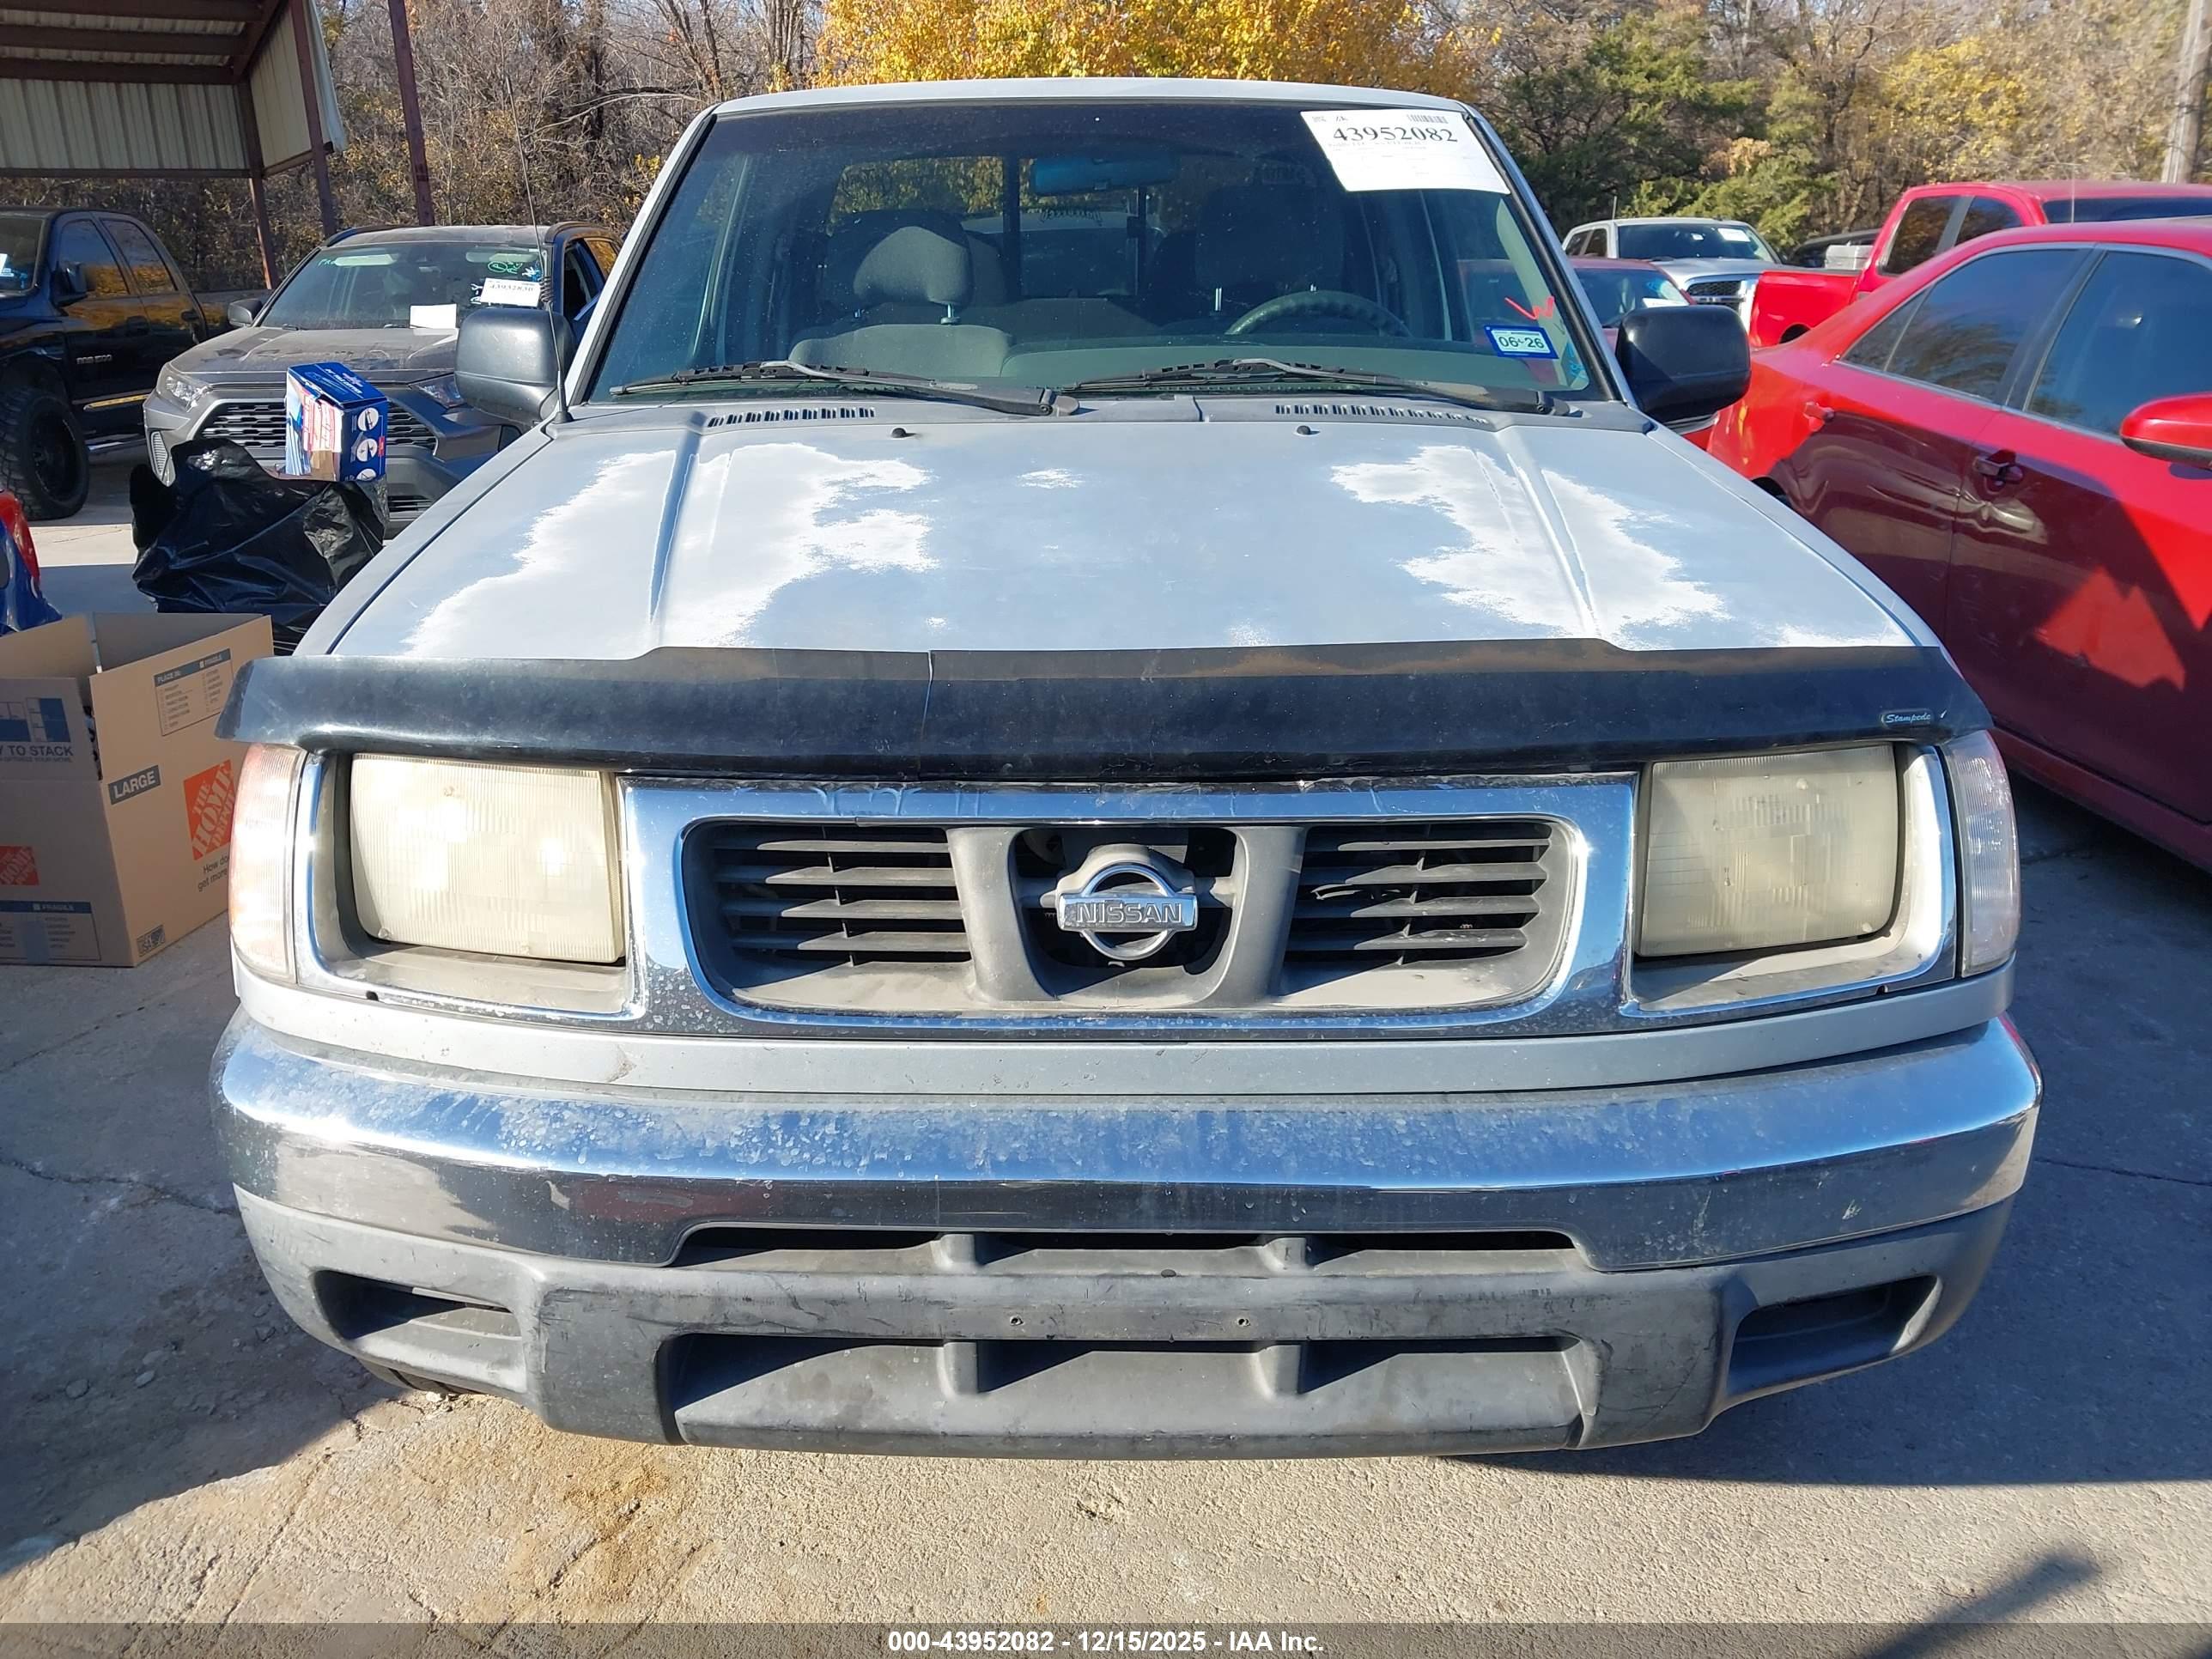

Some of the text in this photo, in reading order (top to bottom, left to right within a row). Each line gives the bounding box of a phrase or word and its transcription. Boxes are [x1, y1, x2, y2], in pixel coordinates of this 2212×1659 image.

[1333, 125, 1458, 143] 43952082
[1498, 336, 1545, 349] 06 26
[1885, 712, 1931, 724] Stampede
[7, 745, 26, 757] TO
[29, 745, 74, 757] STACK
[112, 769, 157, 800] LARGE
[191, 780, 211, 817] THE
[191, 763, 233, 854] HOME
[203, 860, 218, 874] How
[198, 876, 210, 892] get
[1076, 902, 1182, 924] NISSAN
